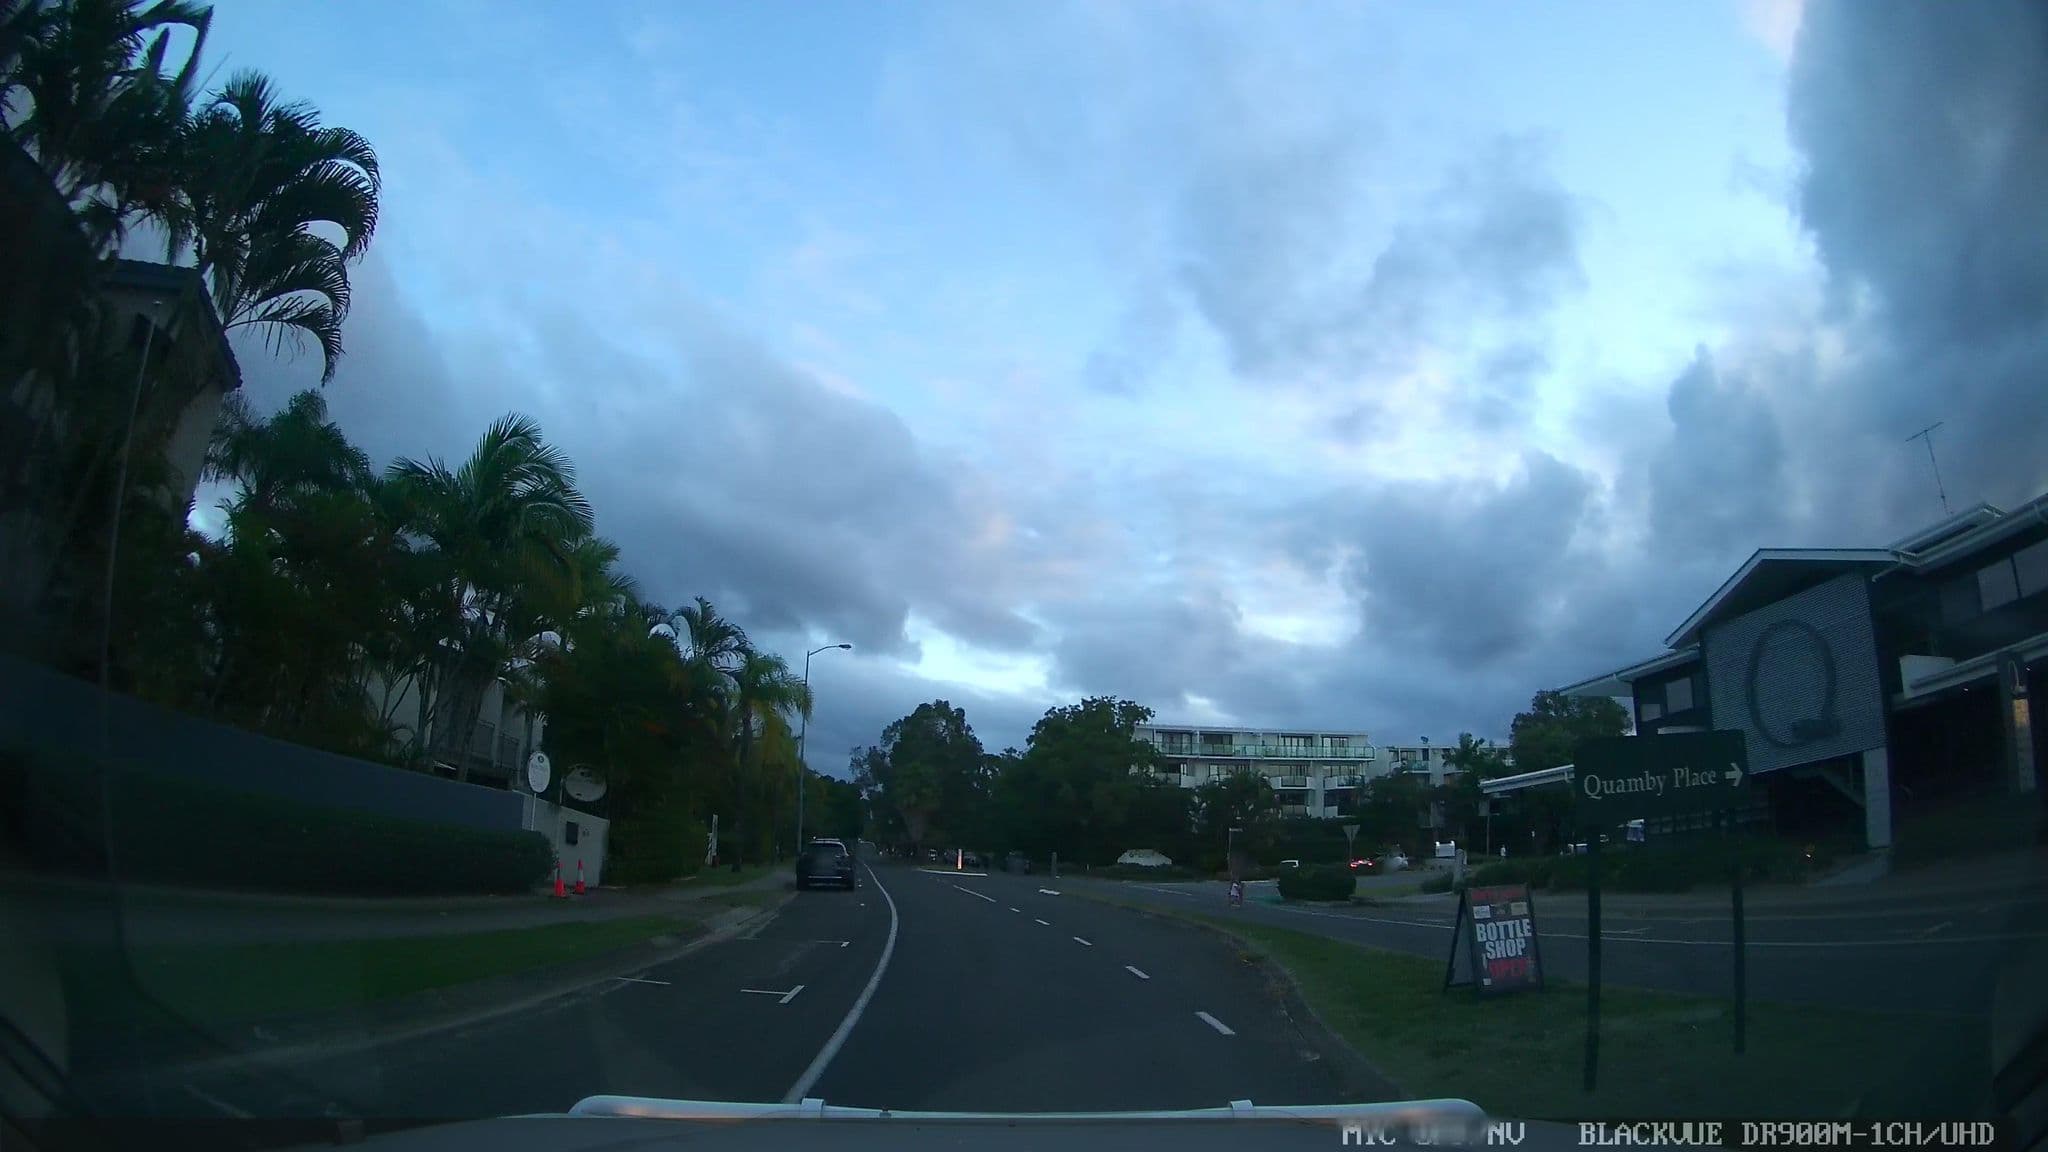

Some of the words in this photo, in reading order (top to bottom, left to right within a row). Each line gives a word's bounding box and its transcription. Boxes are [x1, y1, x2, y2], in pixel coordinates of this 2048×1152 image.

[1583, 770, 1666, 799] Quamby
[1673, 765, 1717, 788] Place
[1475, 919, 1532, 942] BOTTLE
[1485, 938, 1526, 960] SHOP
